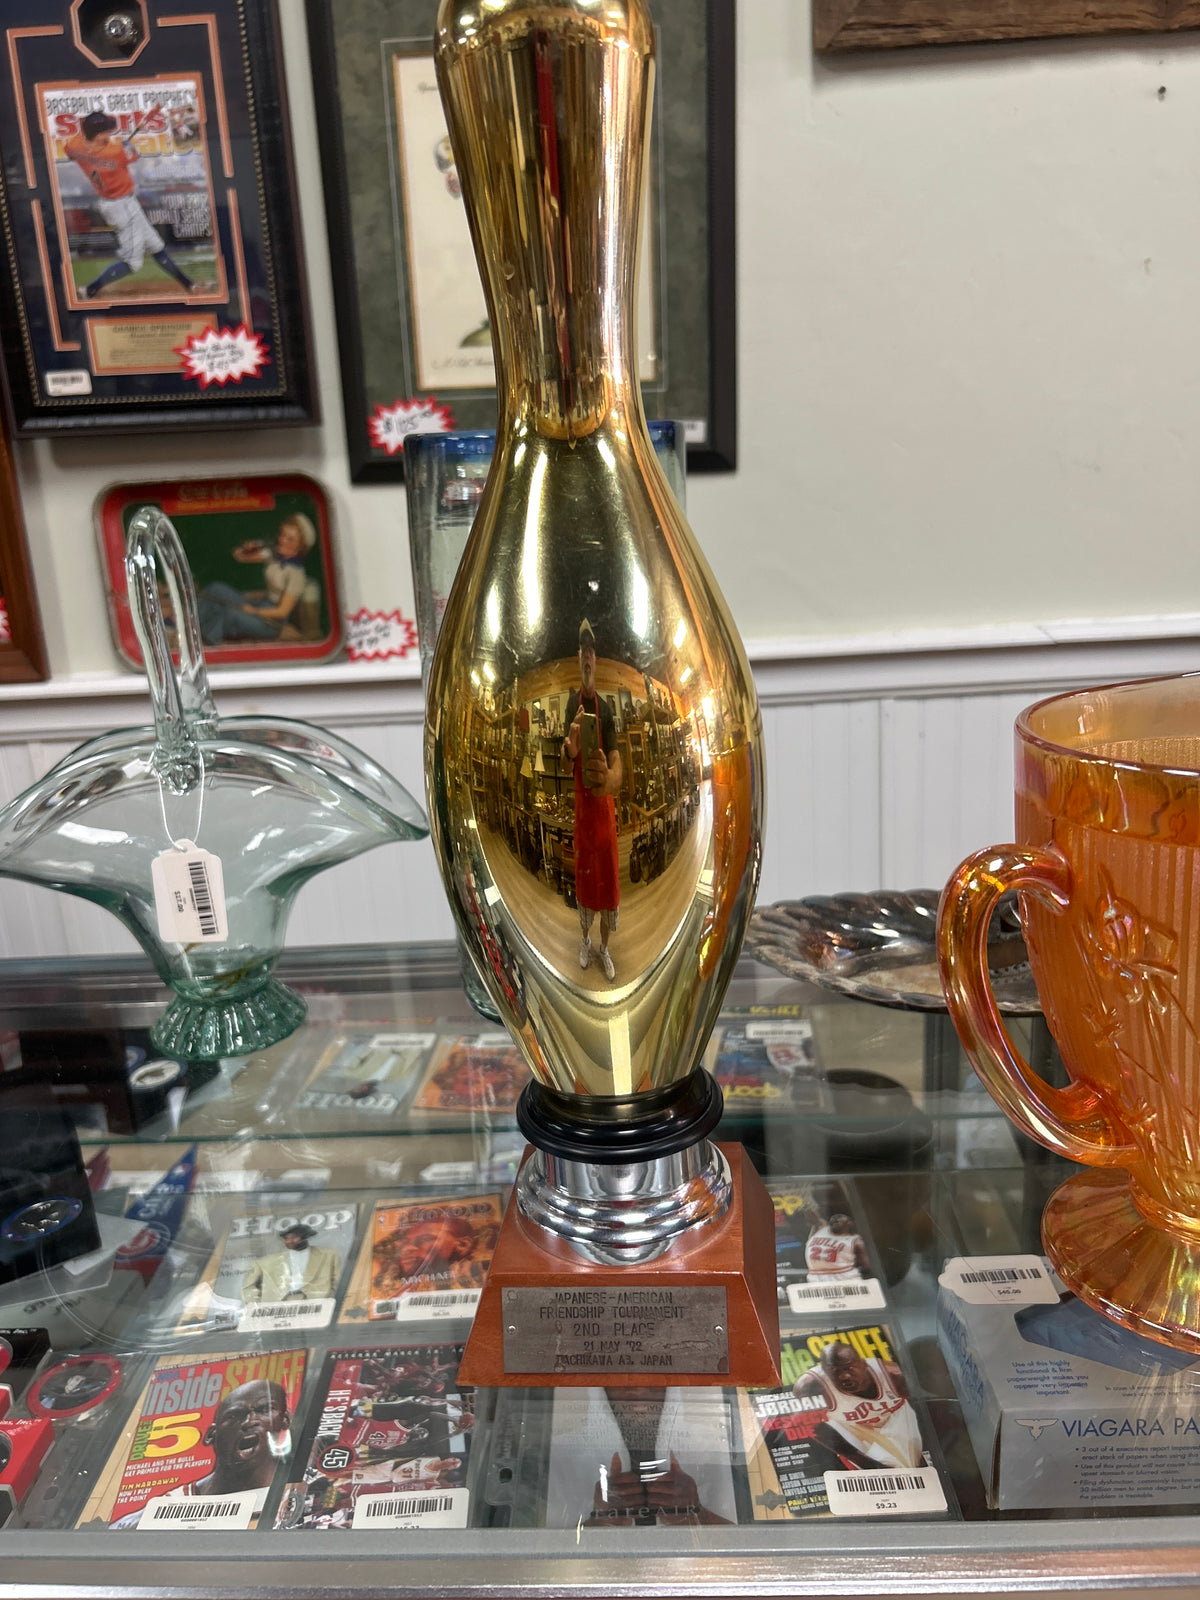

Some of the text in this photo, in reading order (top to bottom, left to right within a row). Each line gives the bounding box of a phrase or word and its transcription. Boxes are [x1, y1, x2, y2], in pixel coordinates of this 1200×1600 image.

[540, 1306, 685, 1320] FRIENDSHIP TOURNAMENT
[573, 1322, 655, 1337] 2ND PLACE
[583, 1341, 594, 1351] 21
[600, 1341, 621, 1352] MAY
[640, 1355, 673, 1366] JAPAN
[1062, 1418, 1165, 1437] VIAGARA
[322, 1448, 350, 1469] 45
[126, 1462, 151, 1471] MICHAEL
[136, 1467, 159, 1475] PRIMED
[184, 1459, 211, 1468] PLAYOFFS
[135, 1477, 179, 1489] HARDAWAY
[129, 1494, 147, 1502] POINT
